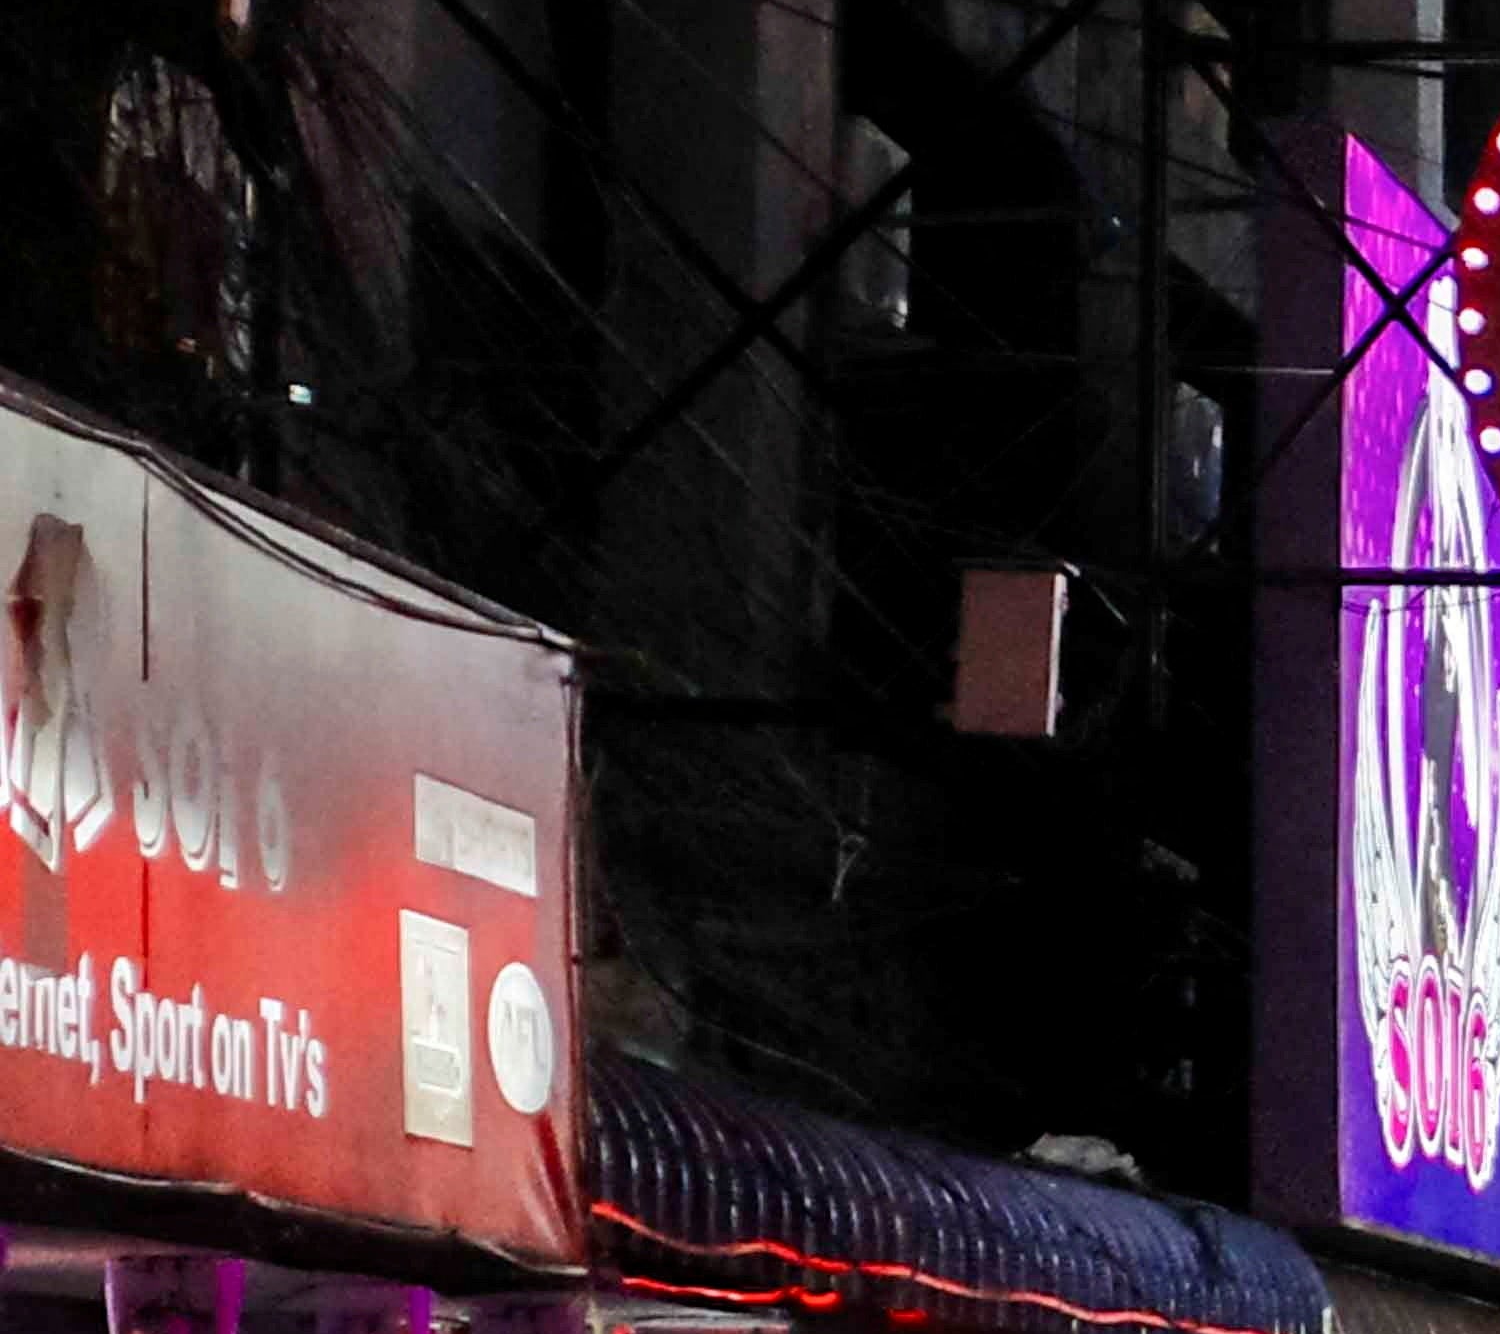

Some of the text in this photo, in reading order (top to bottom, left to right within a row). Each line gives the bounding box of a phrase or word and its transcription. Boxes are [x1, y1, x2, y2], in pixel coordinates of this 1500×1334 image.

[111, 956, 206, 1104] Sport
[211, 1013, 253, 1100] on
[260, 997, 325, 1118] Tv's
